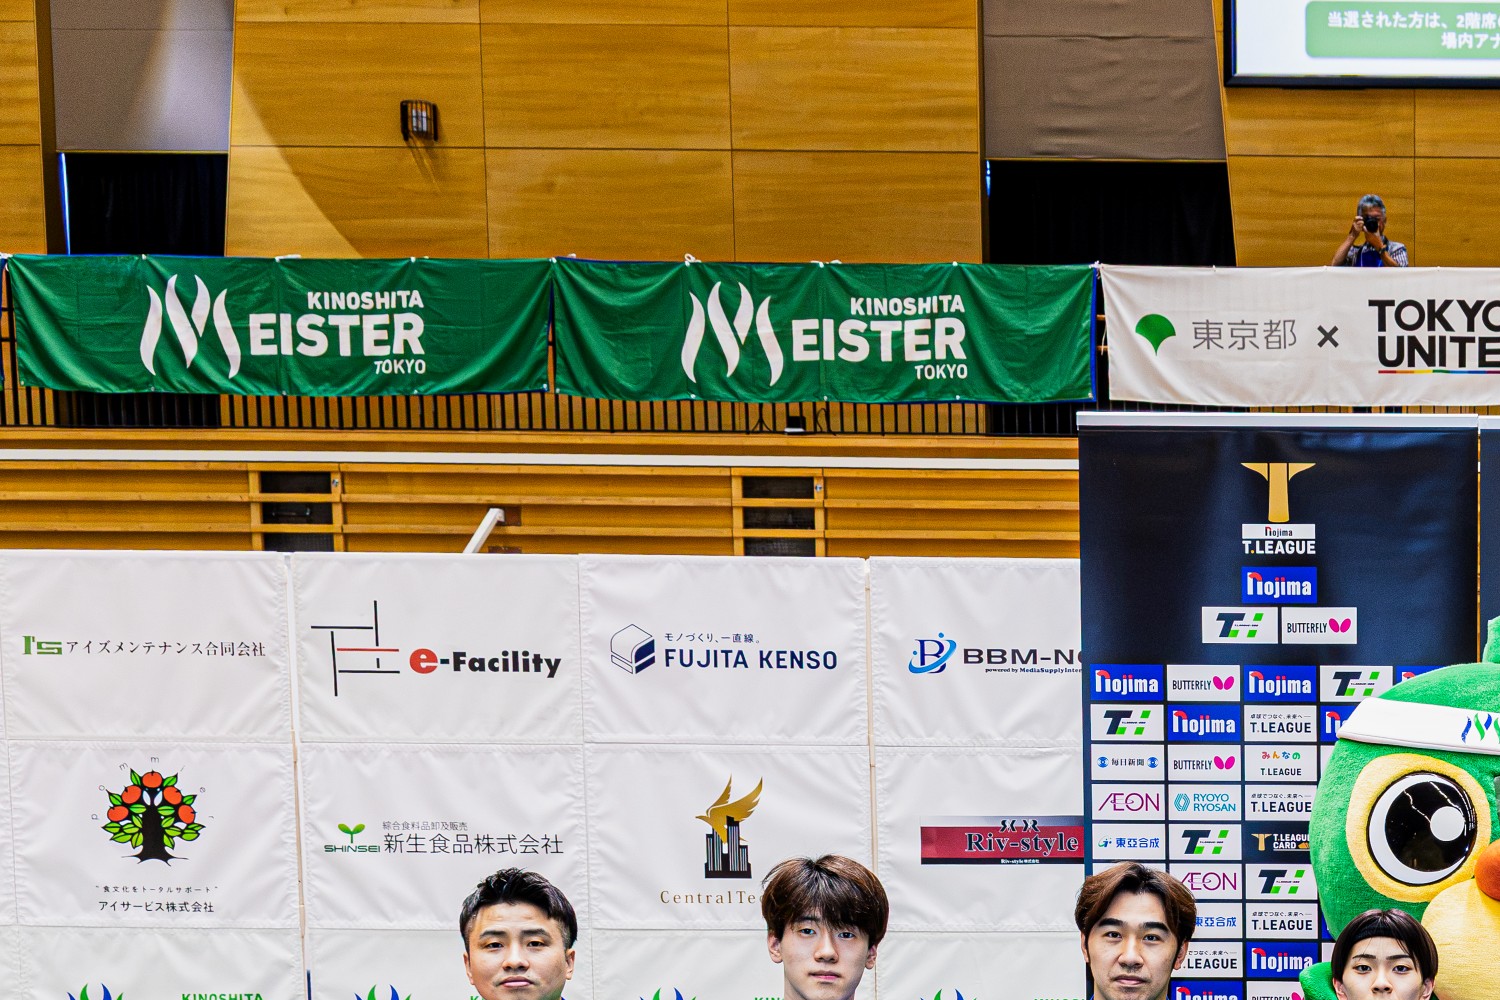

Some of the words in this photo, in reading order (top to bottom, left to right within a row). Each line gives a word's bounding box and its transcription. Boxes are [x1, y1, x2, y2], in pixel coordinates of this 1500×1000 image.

[308, 290, 424, 309] KINOSHITA
[850, 294, 965, 315] KINOSHITA
[1191, 319, 1297, 350] 東京都
[374, 358, 426, 375] TOKYO
[915, 363, 968, 379] TOKYO
[1243, 540, 1316, 554] T.LEAGUE
[1287, 622, 1327, 634] BUTTERFLY
[664, 633, 760, 643] モノづくり、一直線。
[66, 640, 266, 658] アイズメンテナンス合同会社
[665, 649, 749, 668] FUJITA
[760, 651, 837, 670] KENSO
[964, 649, 1081, 664] BBM-N
[409, 648, 562, 678] e-Facility
[1173, 680, 1211, 690] BUTTERFLY
[1250, 722, 1311, 733] T.LEAGUE
[1261, 751, 1301, 760] みんなの
[1111, 758, 1144, 766] 毎日新聞
[1174, 760, 1212, 770] BUTTERFLY
[1261, 768, 1302, 776] T.LEAGUE
[1194, 794, 1229, 802] RYOYO
[1194, 803, 1236, 812] RYOSAN
[1251, 802, 1312, 813] T.LEAGUE
[384, 833, 564, 854] 新生食品株式会社
[965, 832, 1078, 856] Riv-style
[1115, 838, 1160, 849] 東亞合成
[660, 891, 762, 903] CentralTe
[99, 901, 214, 913] アイサービス株式会社
[1252, 919, 1313, 931] T.LEAGUE
